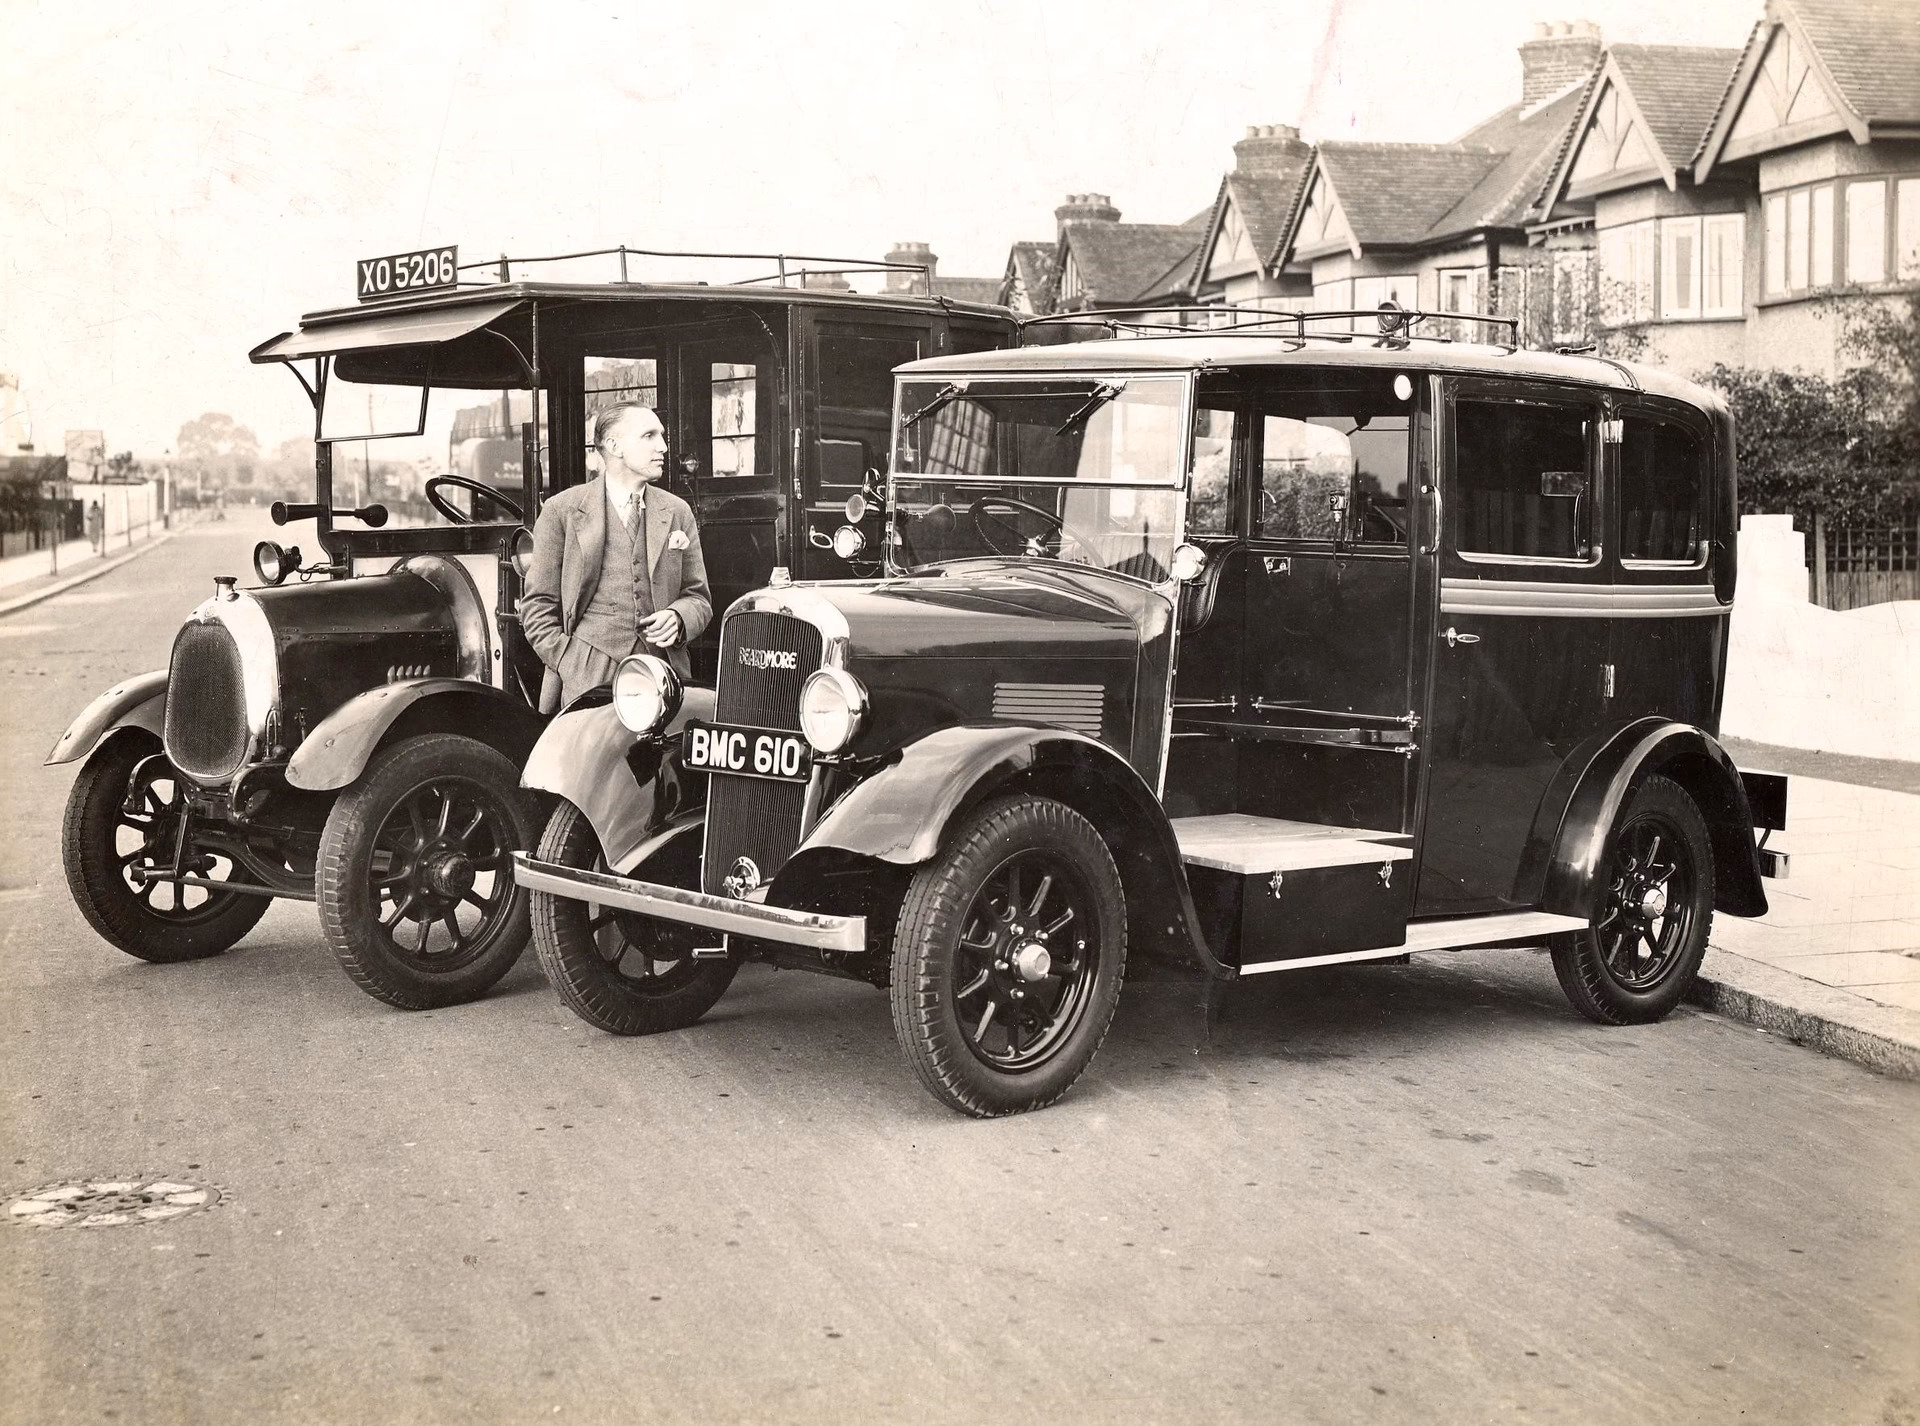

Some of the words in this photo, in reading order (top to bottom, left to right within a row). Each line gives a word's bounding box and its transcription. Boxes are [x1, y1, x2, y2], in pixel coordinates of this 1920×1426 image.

[362, 260, 390, 293] XO
[395, 251, 453, 288] 5206
[739, 646, 797, 669] BEARDMORE
[691, 728, 747, 770] BMC
[754, 735, 800, 776] 610
